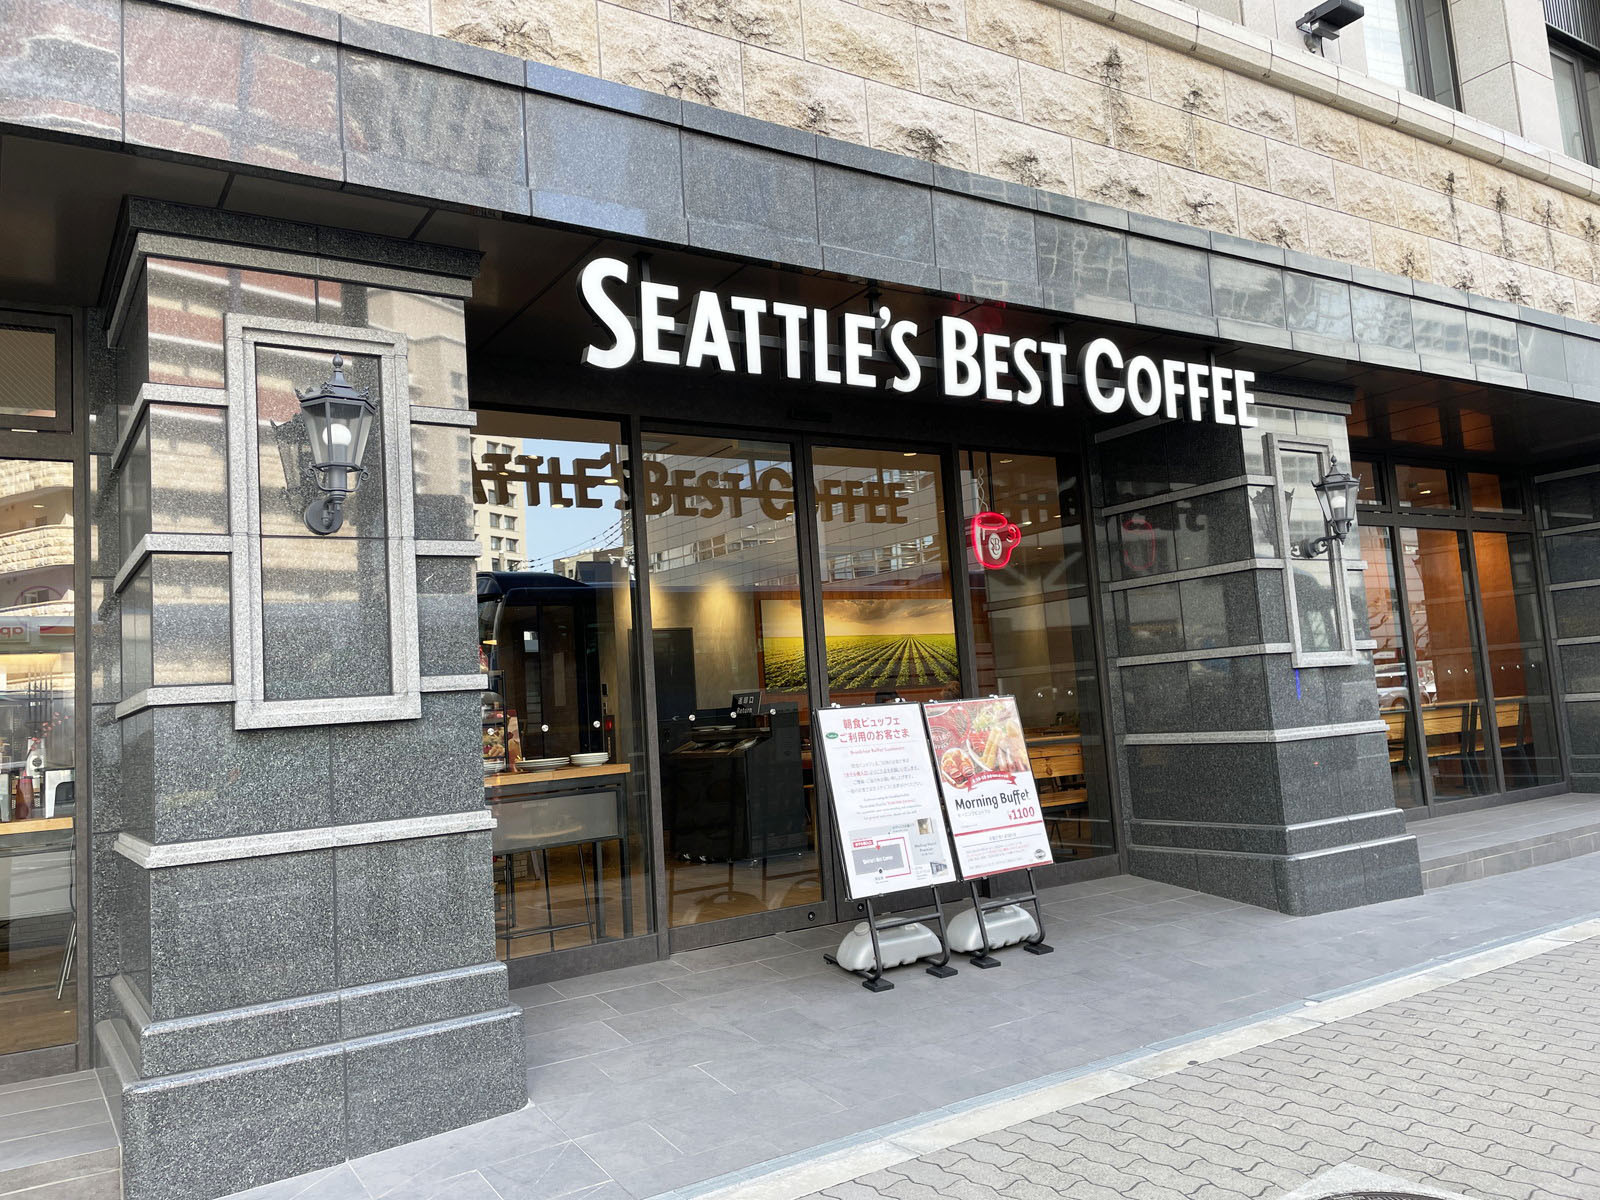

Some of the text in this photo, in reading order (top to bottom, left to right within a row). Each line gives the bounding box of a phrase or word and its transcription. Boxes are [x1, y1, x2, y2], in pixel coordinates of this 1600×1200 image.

[580, 256, 1260, 428] SEATTLE'S BEST COFFEE
[839, 728, 910, 743] ご利用のお客さま
[954, 788, 1032, 811] Morning Buffet
[1008, 806, 1035, 821] ¥1100
